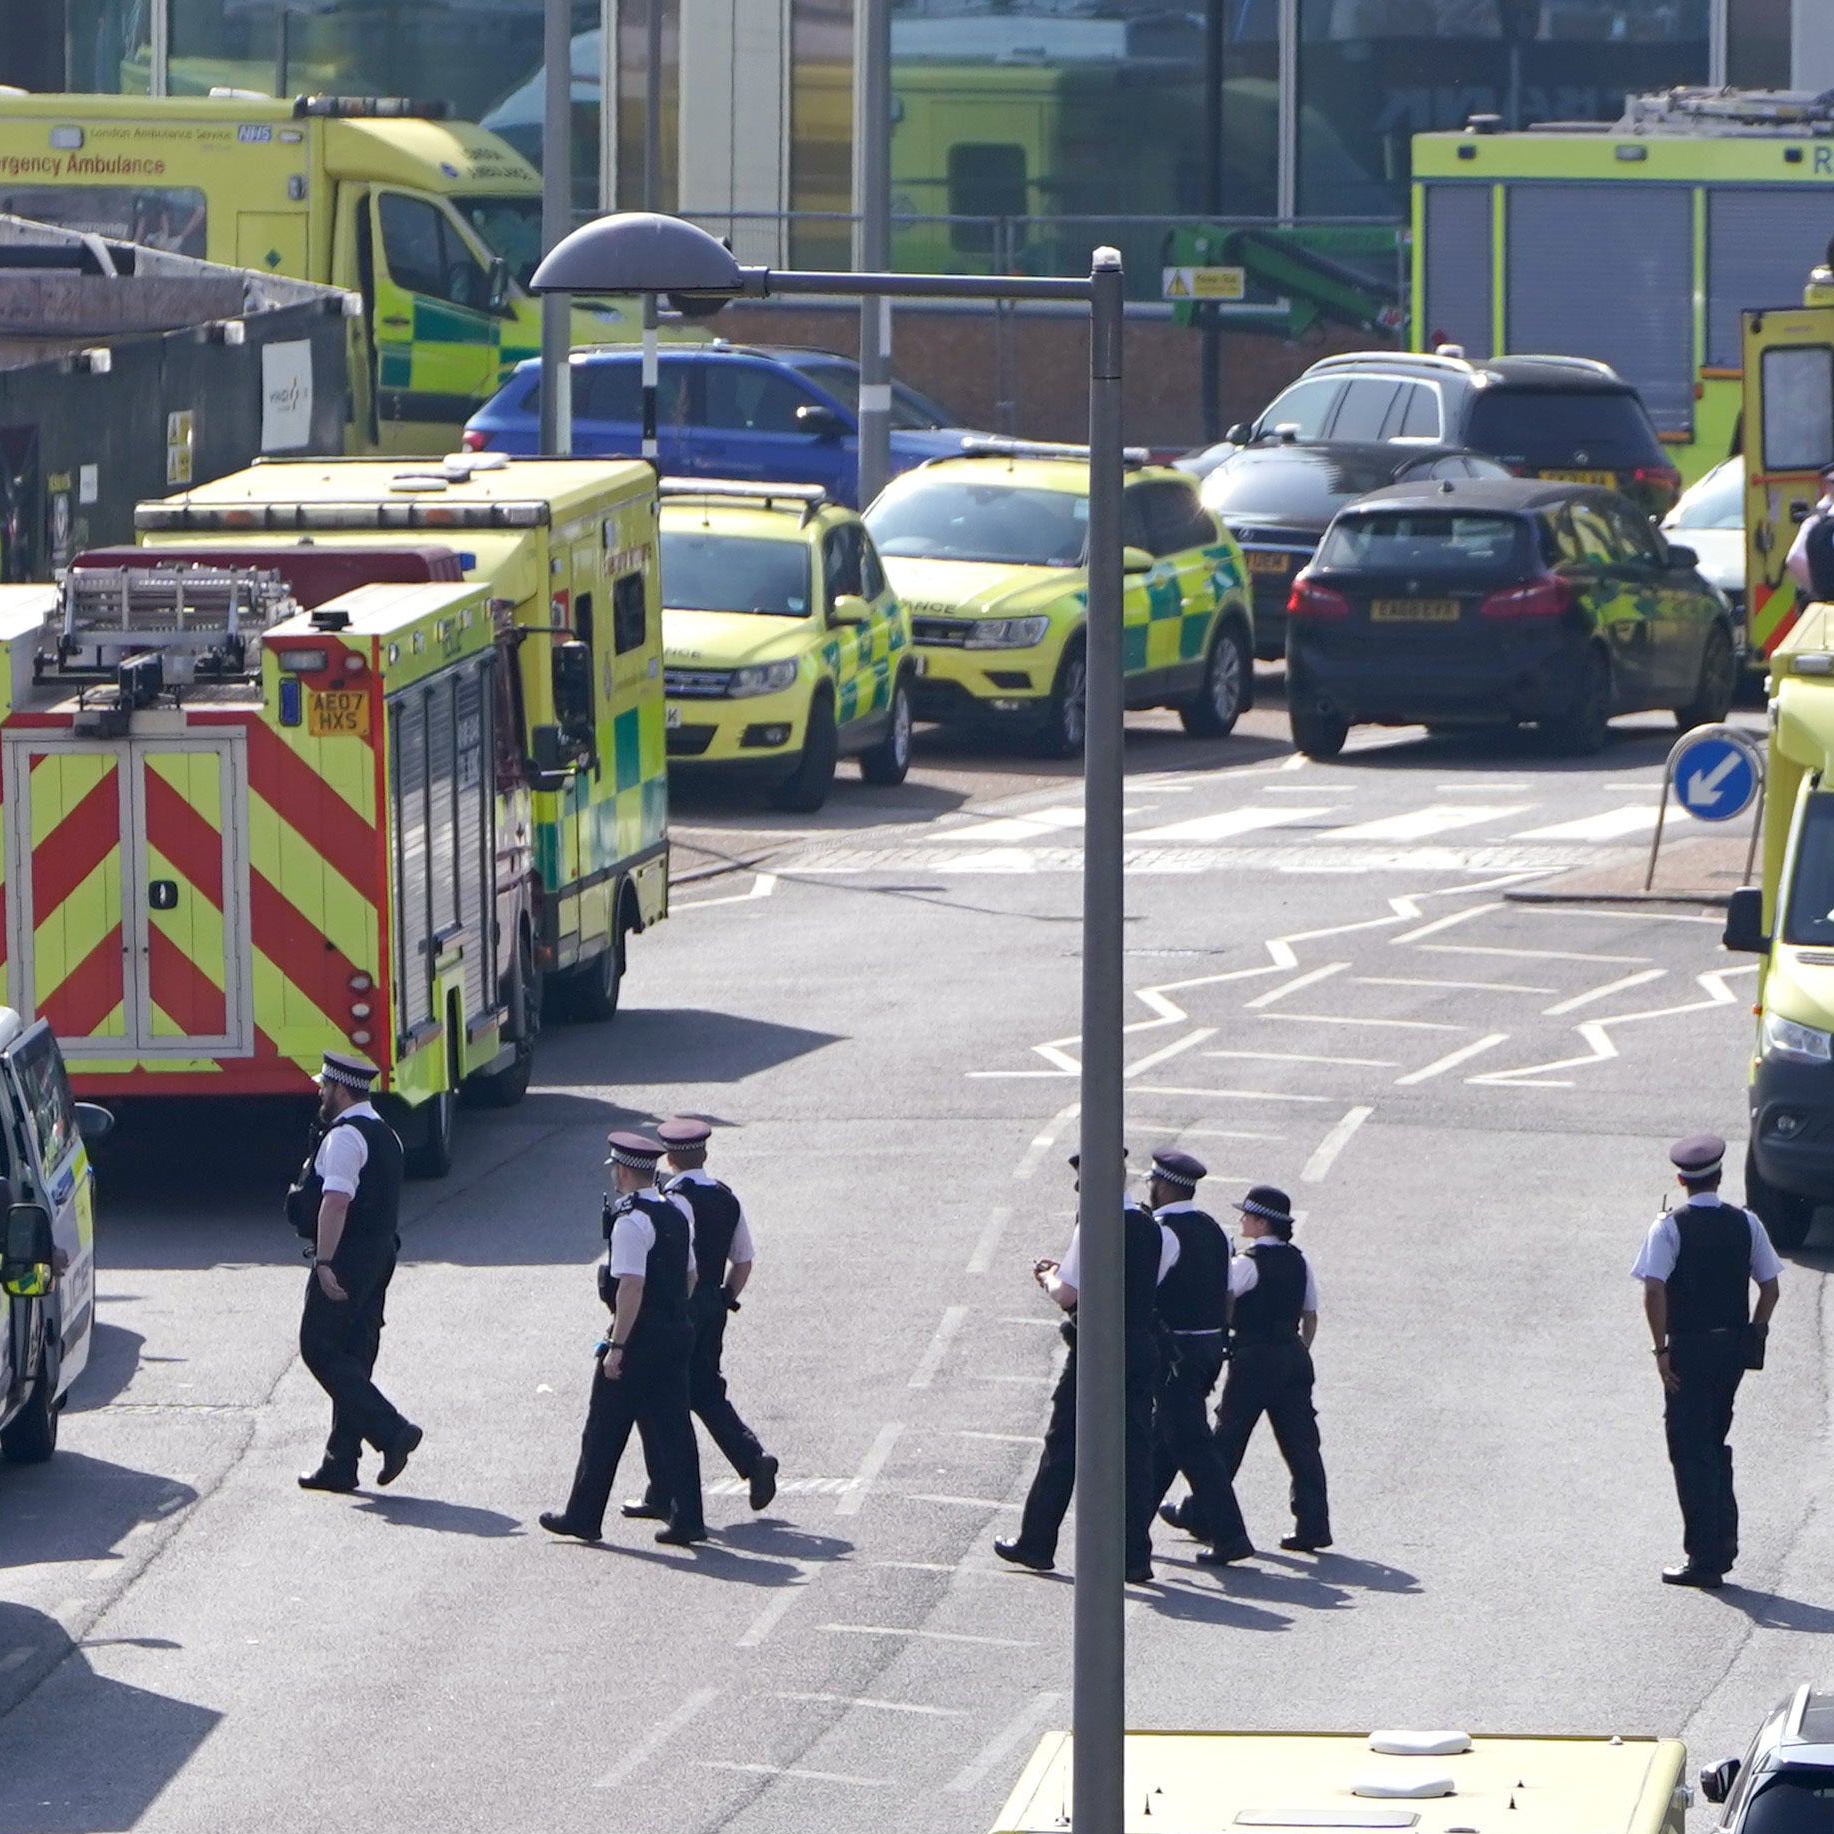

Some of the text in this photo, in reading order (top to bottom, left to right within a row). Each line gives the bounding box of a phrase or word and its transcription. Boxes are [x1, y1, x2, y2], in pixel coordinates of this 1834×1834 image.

[239, 126, 272, 142] NHS
[67, 152, 166, 176] Ambulance
[313, 694, 363, 712] AE07
[319, 711, 358, 731] HXS
